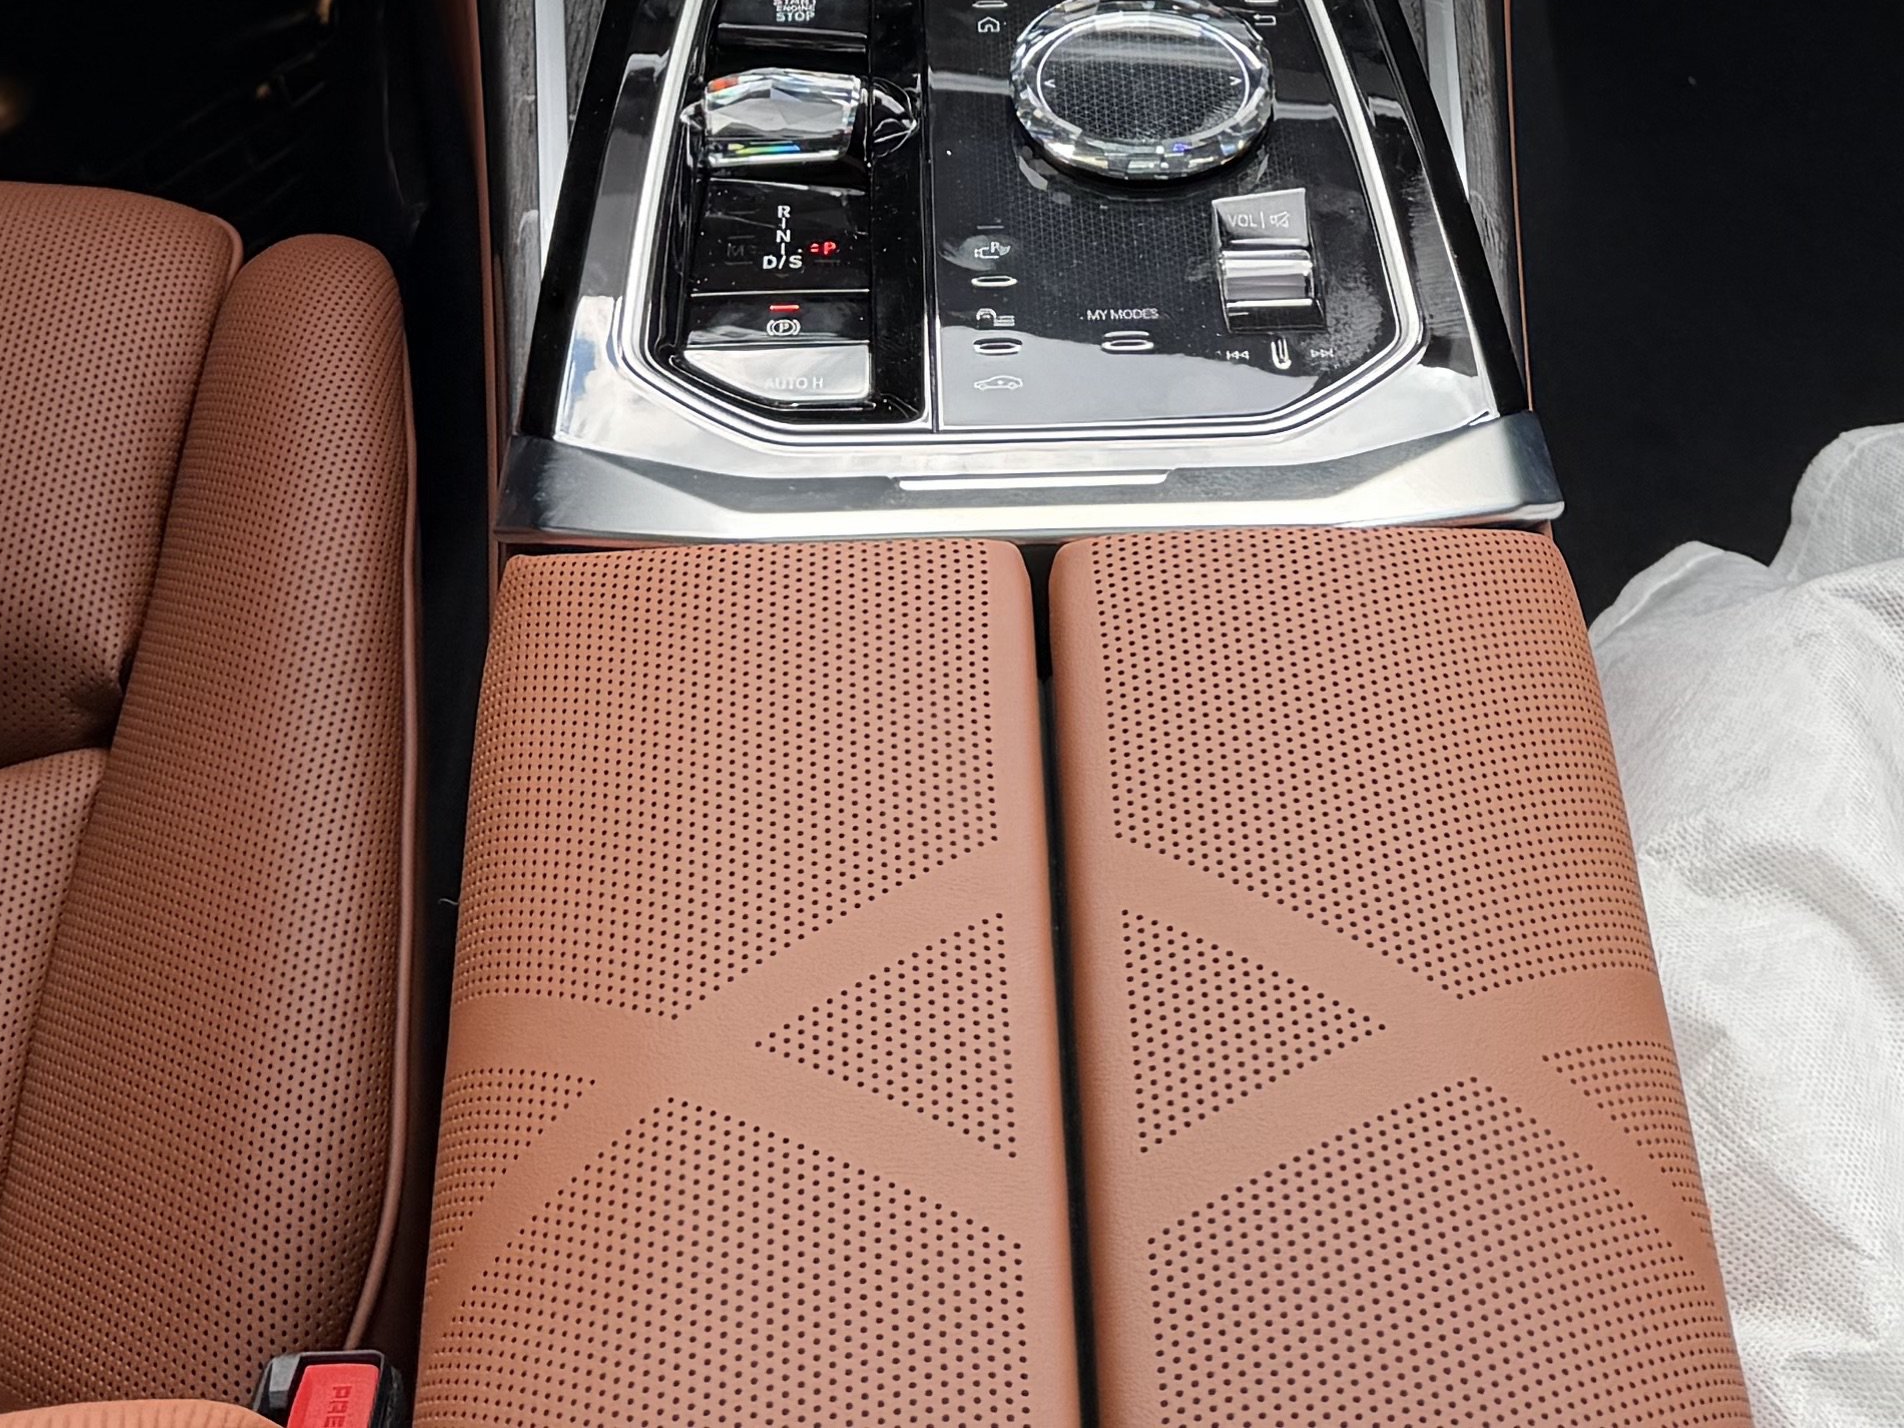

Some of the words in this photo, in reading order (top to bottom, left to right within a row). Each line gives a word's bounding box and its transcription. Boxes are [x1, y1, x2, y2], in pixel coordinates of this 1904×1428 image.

[775, 11, 816, 22] STOP
[777, 204, 792, 219] R
[1226, 213, 1258, 229] VOL
[775, 229, 792, 243] N
[823, 241, 837, 255] P
[762, 254, 804, 270] D/S
[1086, 308, 1108, 321] MY
[1109, 307, 1160, 320] MODES
[764, 376, 809, 390] AUTO
[812, 376, 824, 389] H
